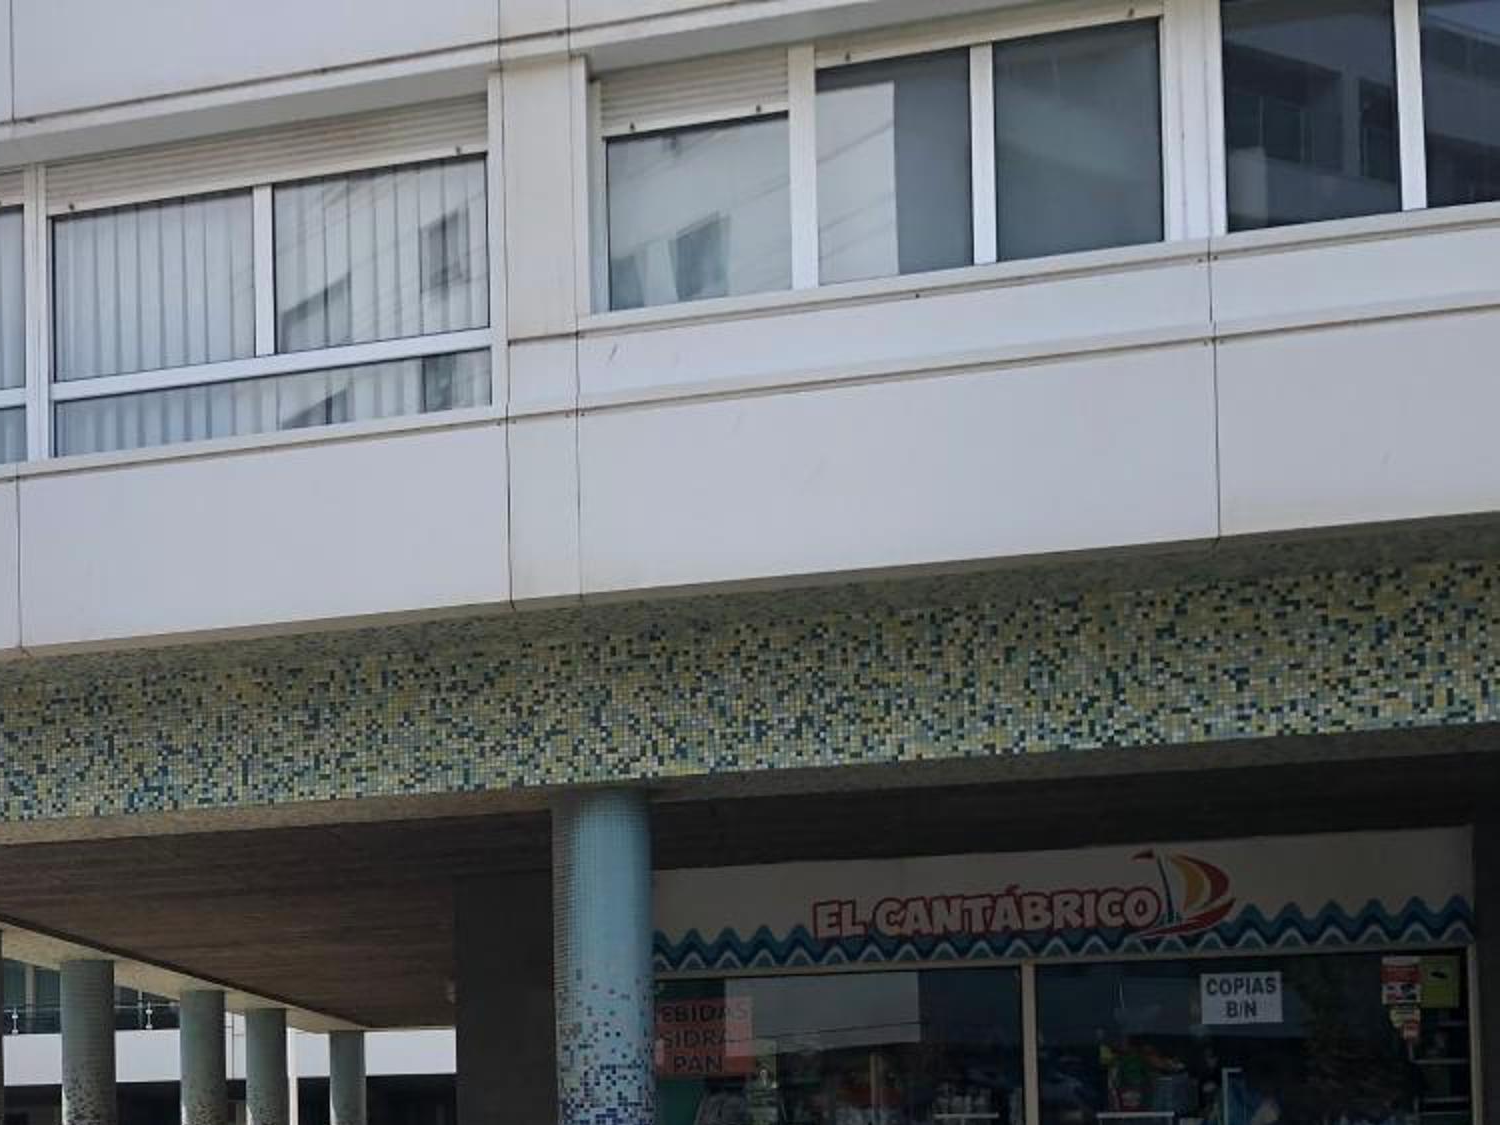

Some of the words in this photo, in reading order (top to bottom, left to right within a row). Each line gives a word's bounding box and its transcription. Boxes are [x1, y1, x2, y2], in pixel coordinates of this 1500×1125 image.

[814, 899, 866, 939] EL
[872, 883, 1162, 938] CANTÁBRICO
[1206, 976, 1277, 996] COPIAS
[656, 1004, 749, 1023] EBIDAS
[675, 1055, 723, 1073] PAN
